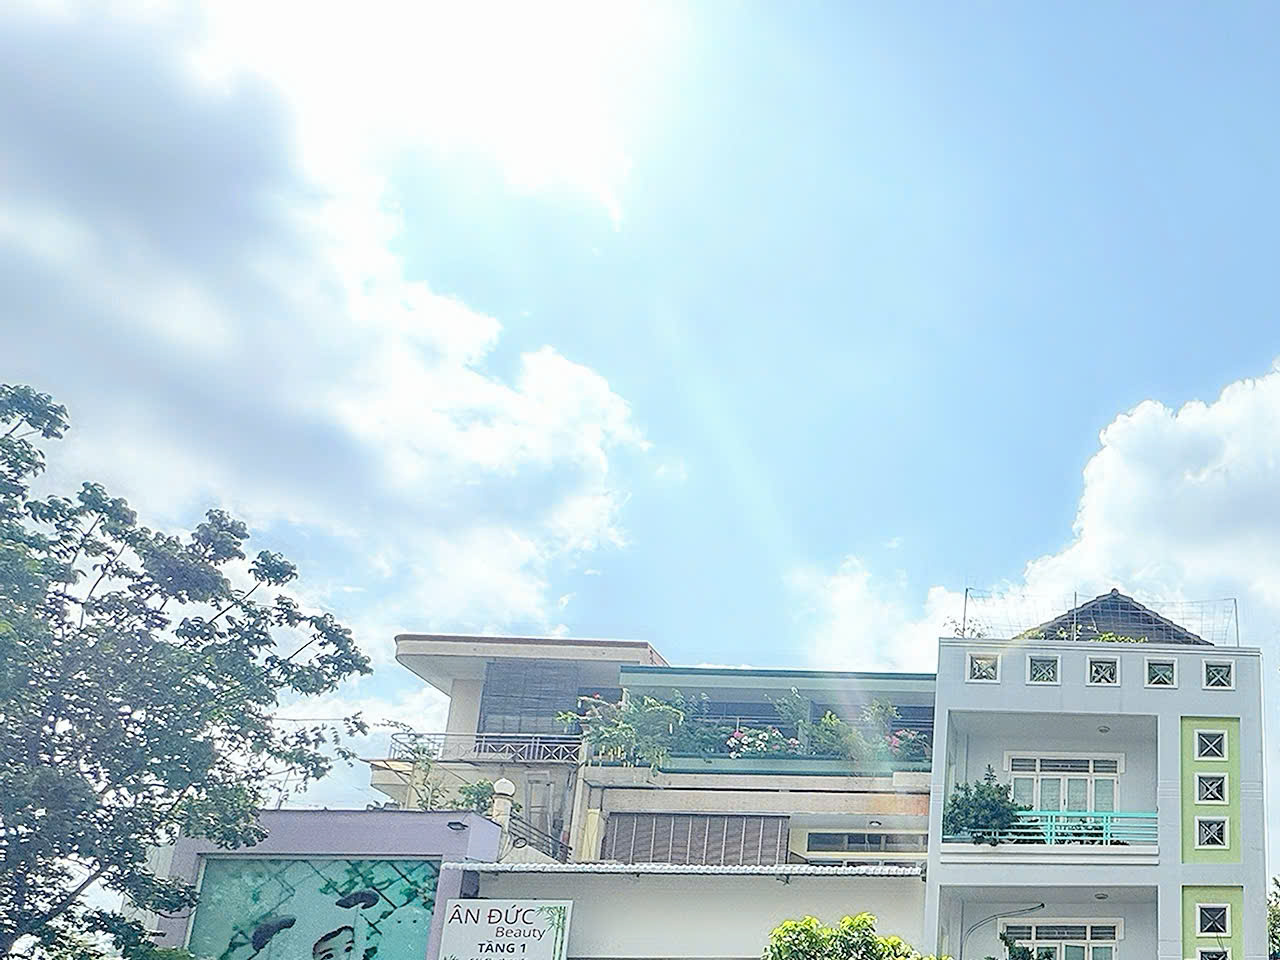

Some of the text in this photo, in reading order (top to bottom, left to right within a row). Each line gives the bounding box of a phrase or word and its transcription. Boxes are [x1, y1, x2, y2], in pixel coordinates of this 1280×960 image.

[448, 904, 535, 924] ÂN ĐỨC
[495, 927, 545, 941] Beauty
[478, 940, 526, 953] TẦNG 1
